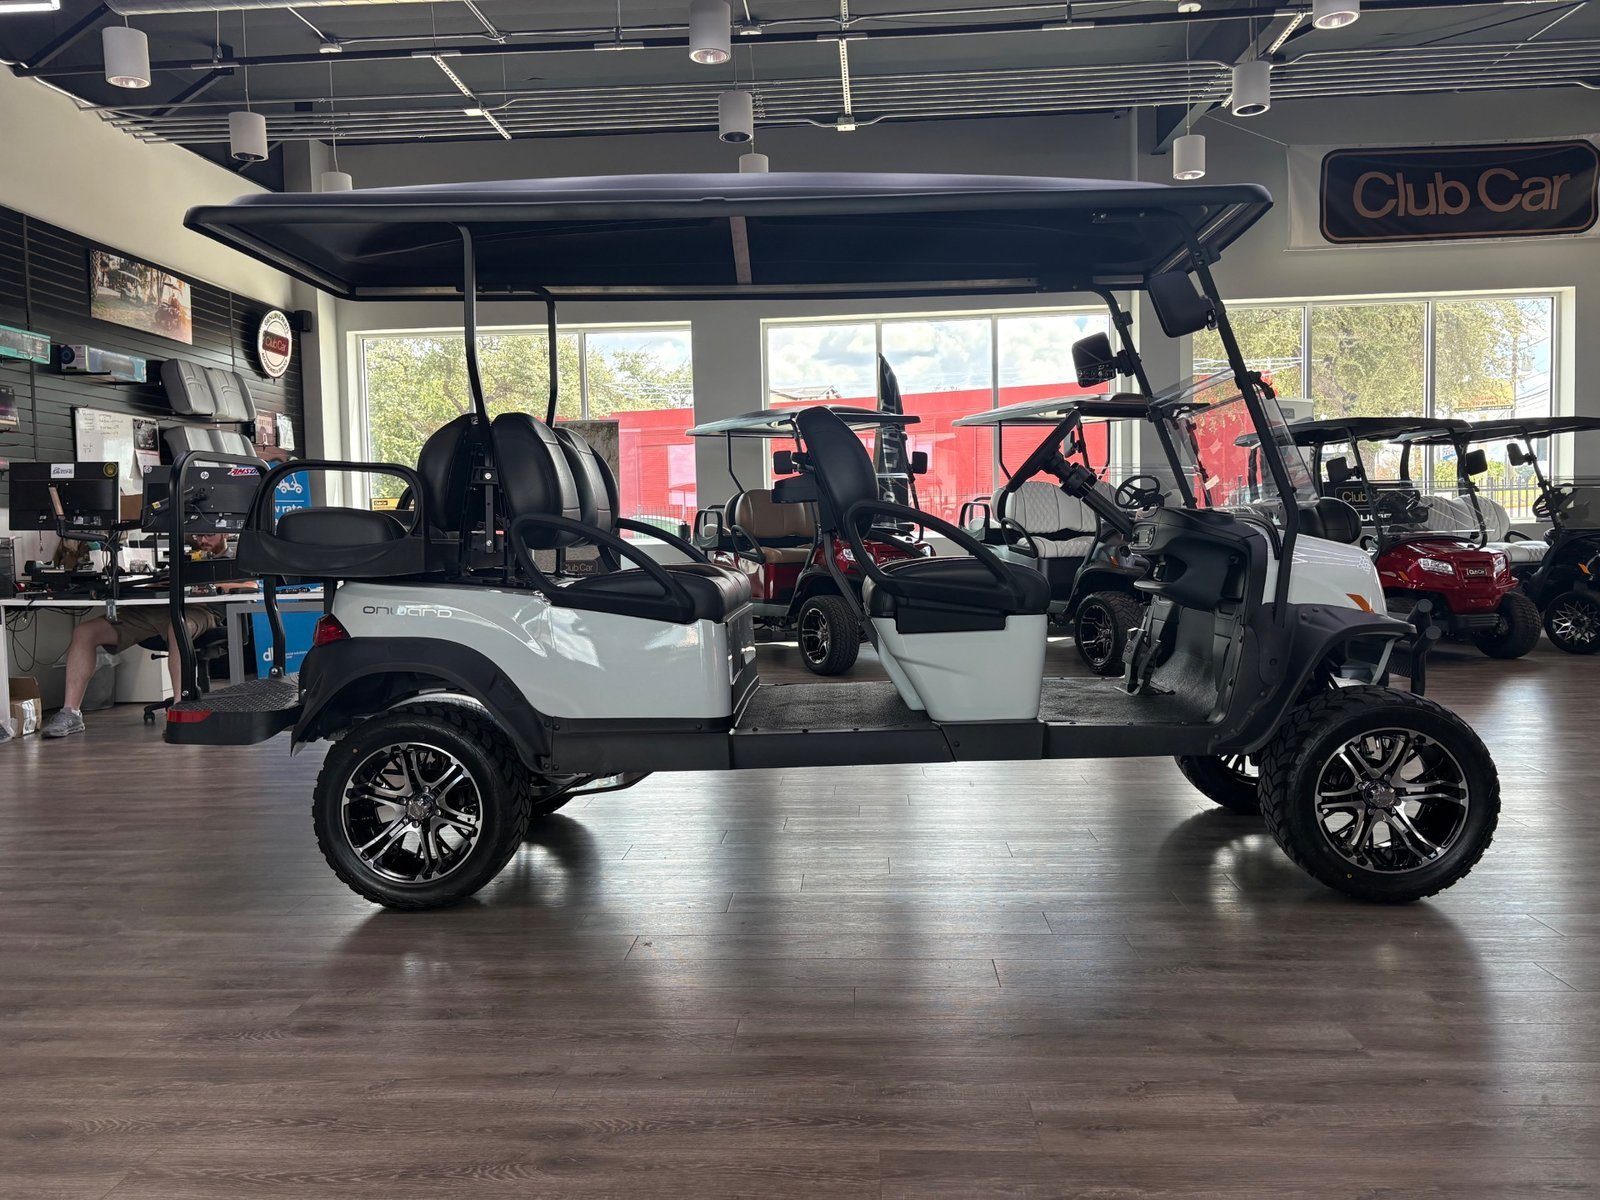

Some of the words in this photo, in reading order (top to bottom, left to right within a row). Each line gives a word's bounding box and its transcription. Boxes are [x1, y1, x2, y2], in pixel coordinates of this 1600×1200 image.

[1353, 171, 1471, 219] Club
[1477, 167, 1571, 213] Car
[265, 336, 277, 348] Club
[277, 340, 287, 351] Car
[1342, 491, 1368, 502] Club
[579, 563, 593, 572] Car
